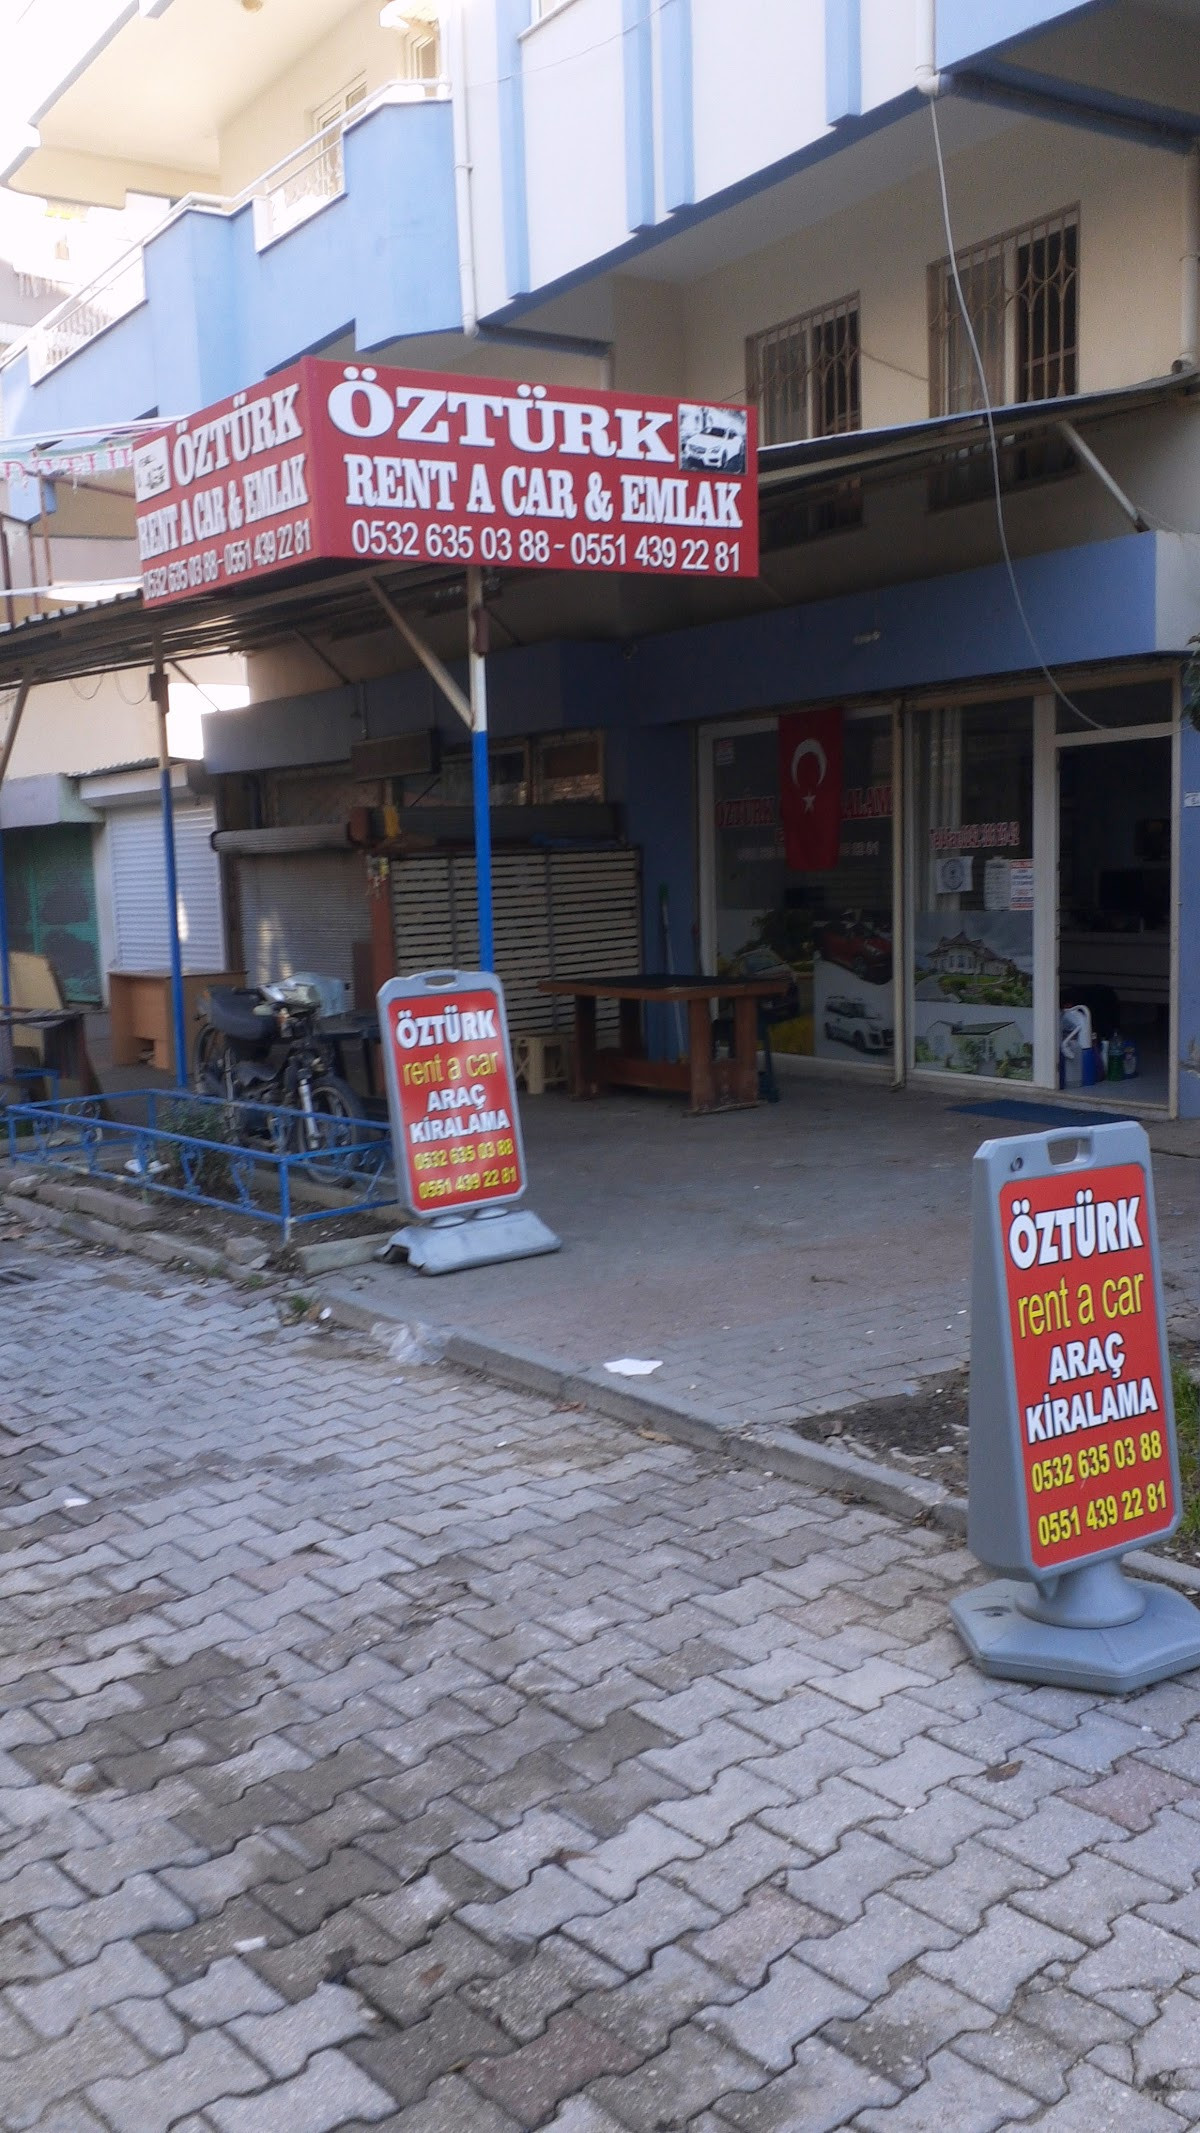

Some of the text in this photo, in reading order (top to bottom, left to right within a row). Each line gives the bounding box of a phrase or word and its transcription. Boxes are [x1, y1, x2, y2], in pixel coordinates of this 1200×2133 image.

[173, 383, 303, 486] ÖZTÜRK
[328, 366, 676, 463] ÖZTÜRK
[137, 453, 309, 560] RENT A CAR & EMLAK
[344, 454, 743, 528] RENT A CAR & EMLAK
[224, 539, 253, 576] 0551
[254, 530, 276, 566] 439
[277, 523, 293, 560] 22
[294, 518, 311, 554] 81
[351, 519, 418, 557] 0532
[425, 523, 474, 560] 635
[481, 526, 513, 562] 03
[519, 528, 550, 564] 88
[571, 531, 626, 568] 0551
[634, 534, 676, 570] 439
[681, 538, 709, 572] 22
[714, 541, 740, 573] 81
[396, 1004, 498, 1050] ÖZTÜRK
[402, 1051, 499, 1087] rent a car
[427, 1084, 487, 1112] ARAÇ
[409, 1109, 512, 1144] KİRALAMA
[414, 1138, 514, 1171] 0532 635 03 88
[419, 1165, 517, 1200] 0551 439 22 81
[1008, 1188, 1144, 1270] ÖZTÜRK
[1017, 1271, 1145, 1338] rent a car
[1047, 1331, 1127, 1386] ARAÇ
[1025, 1376, 1159, 1444] KİRALAMA
[1031, 1429, 1163, 1494] 0532 635 03 88
[1037, 1479, 1167, 1547] 0551 439 22 81
